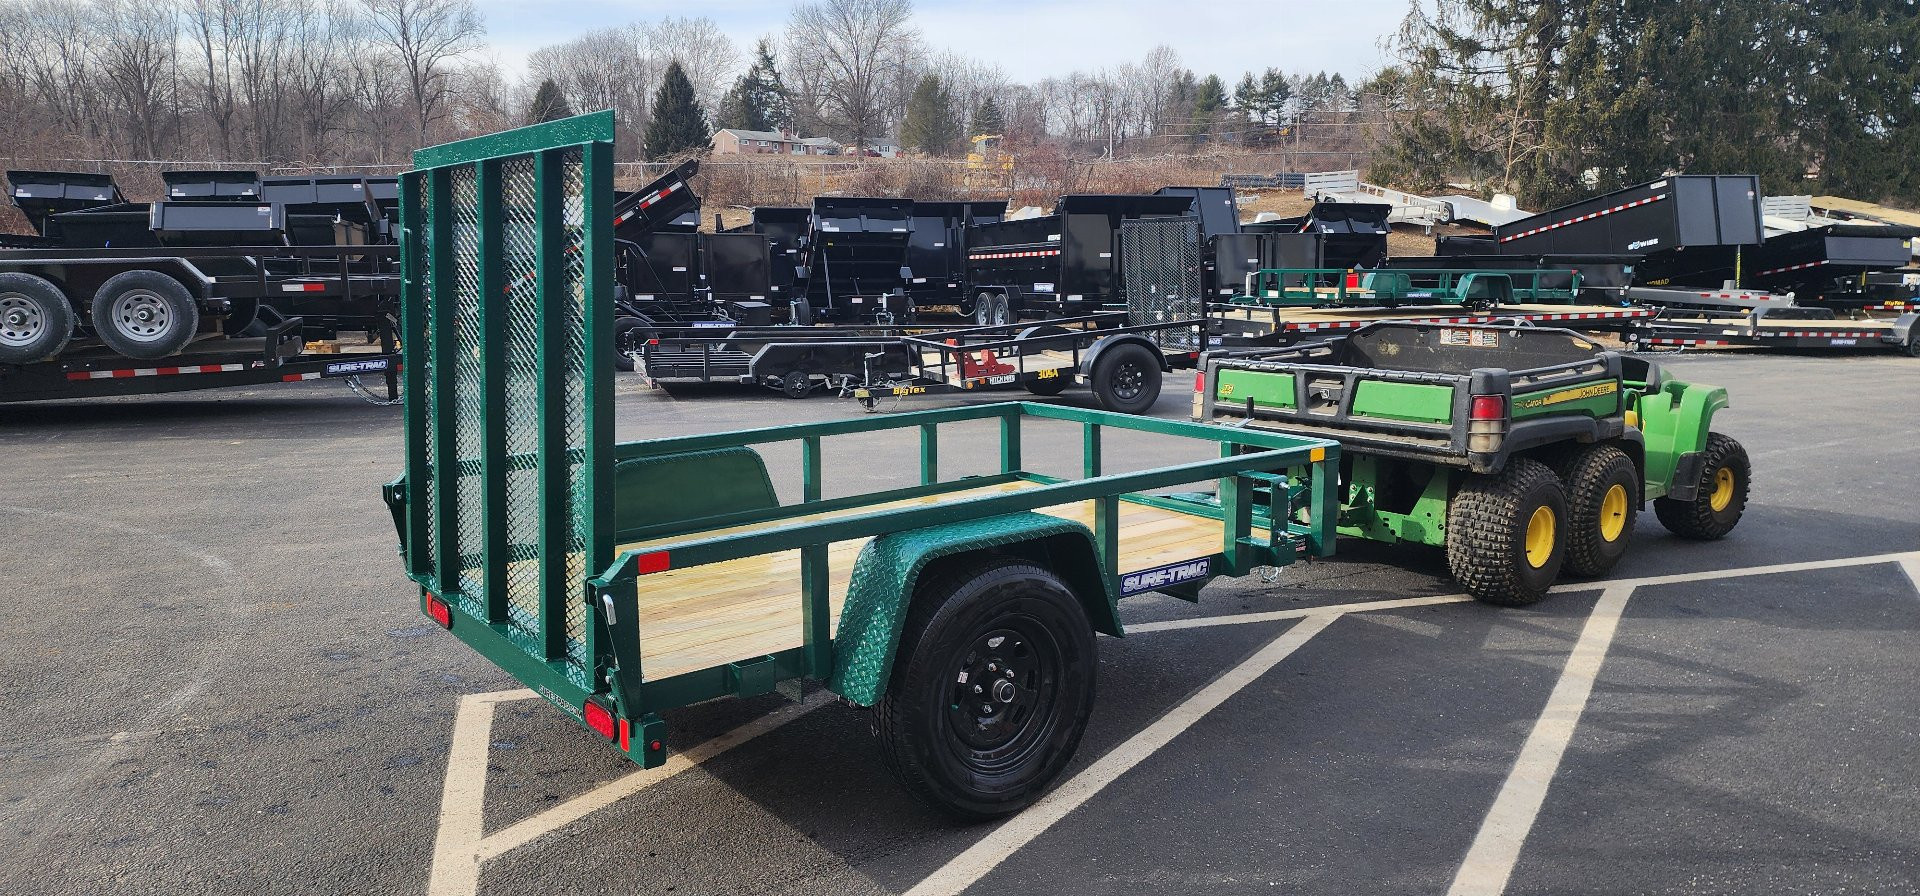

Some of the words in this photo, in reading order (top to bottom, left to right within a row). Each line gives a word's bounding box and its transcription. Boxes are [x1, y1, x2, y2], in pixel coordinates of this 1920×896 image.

[328, 360, 387, 373] SURE-TRAC
[1579, 389, 1594, 398] JOHN
[1593, 385, 1610, 396] DEERE
[1122, 561, 1208, 593] SURE-TRAC
